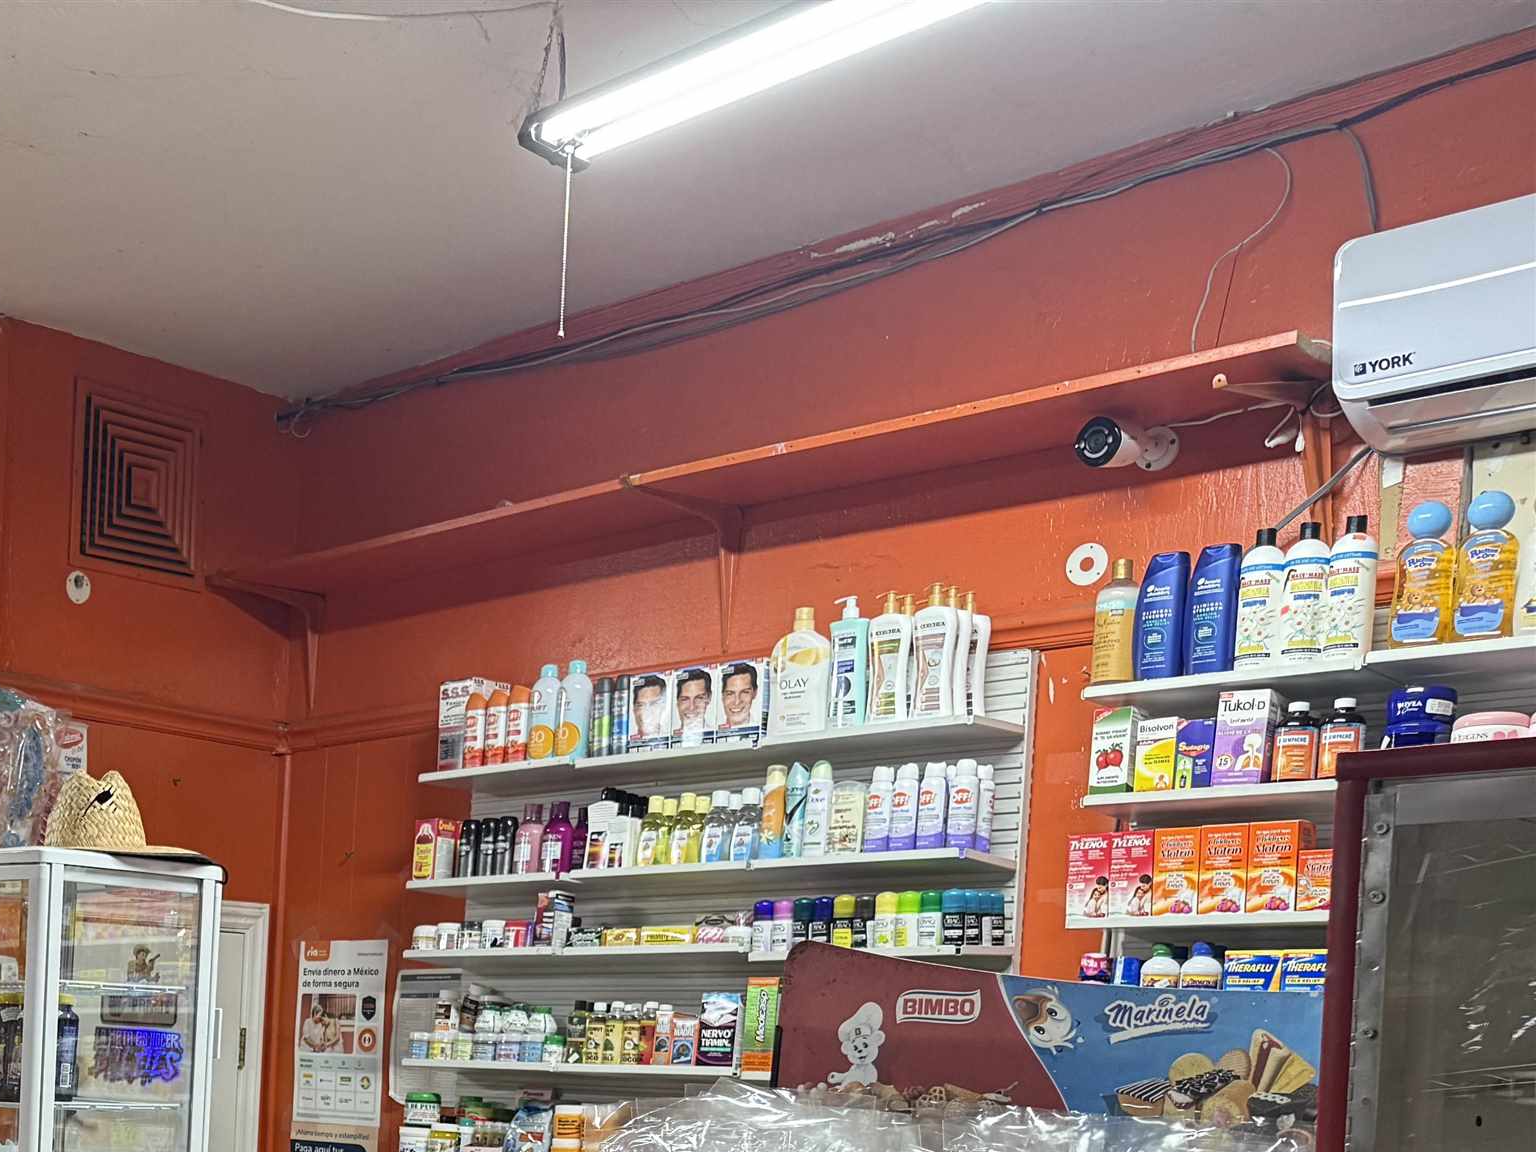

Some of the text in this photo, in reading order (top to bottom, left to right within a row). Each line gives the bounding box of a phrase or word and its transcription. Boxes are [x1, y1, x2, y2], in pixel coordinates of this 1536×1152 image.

[1368, 353, 1414, 373] YORK
[779, 676, 809, 691] OLAY
[1140, 723, 1174, 734] Bisolvon
[1069, 841, 1108, 850] TYLENOL
[1111, 838, 1151, 848] TYLENOL
[322, 967, 345, 977] dinero
[353, 966, 379, 976] México
[1226, 961, 1273, 973] THERAFLU
[1285, 961, 1327, 973] THERAFL
[302, 979, 360, 991] de forma segura
[901, 997, 977, 1018] BIMBO
[1108, 996, 1207, 1028] Marinela
[701, 1029, 732, 1038] NERVO
